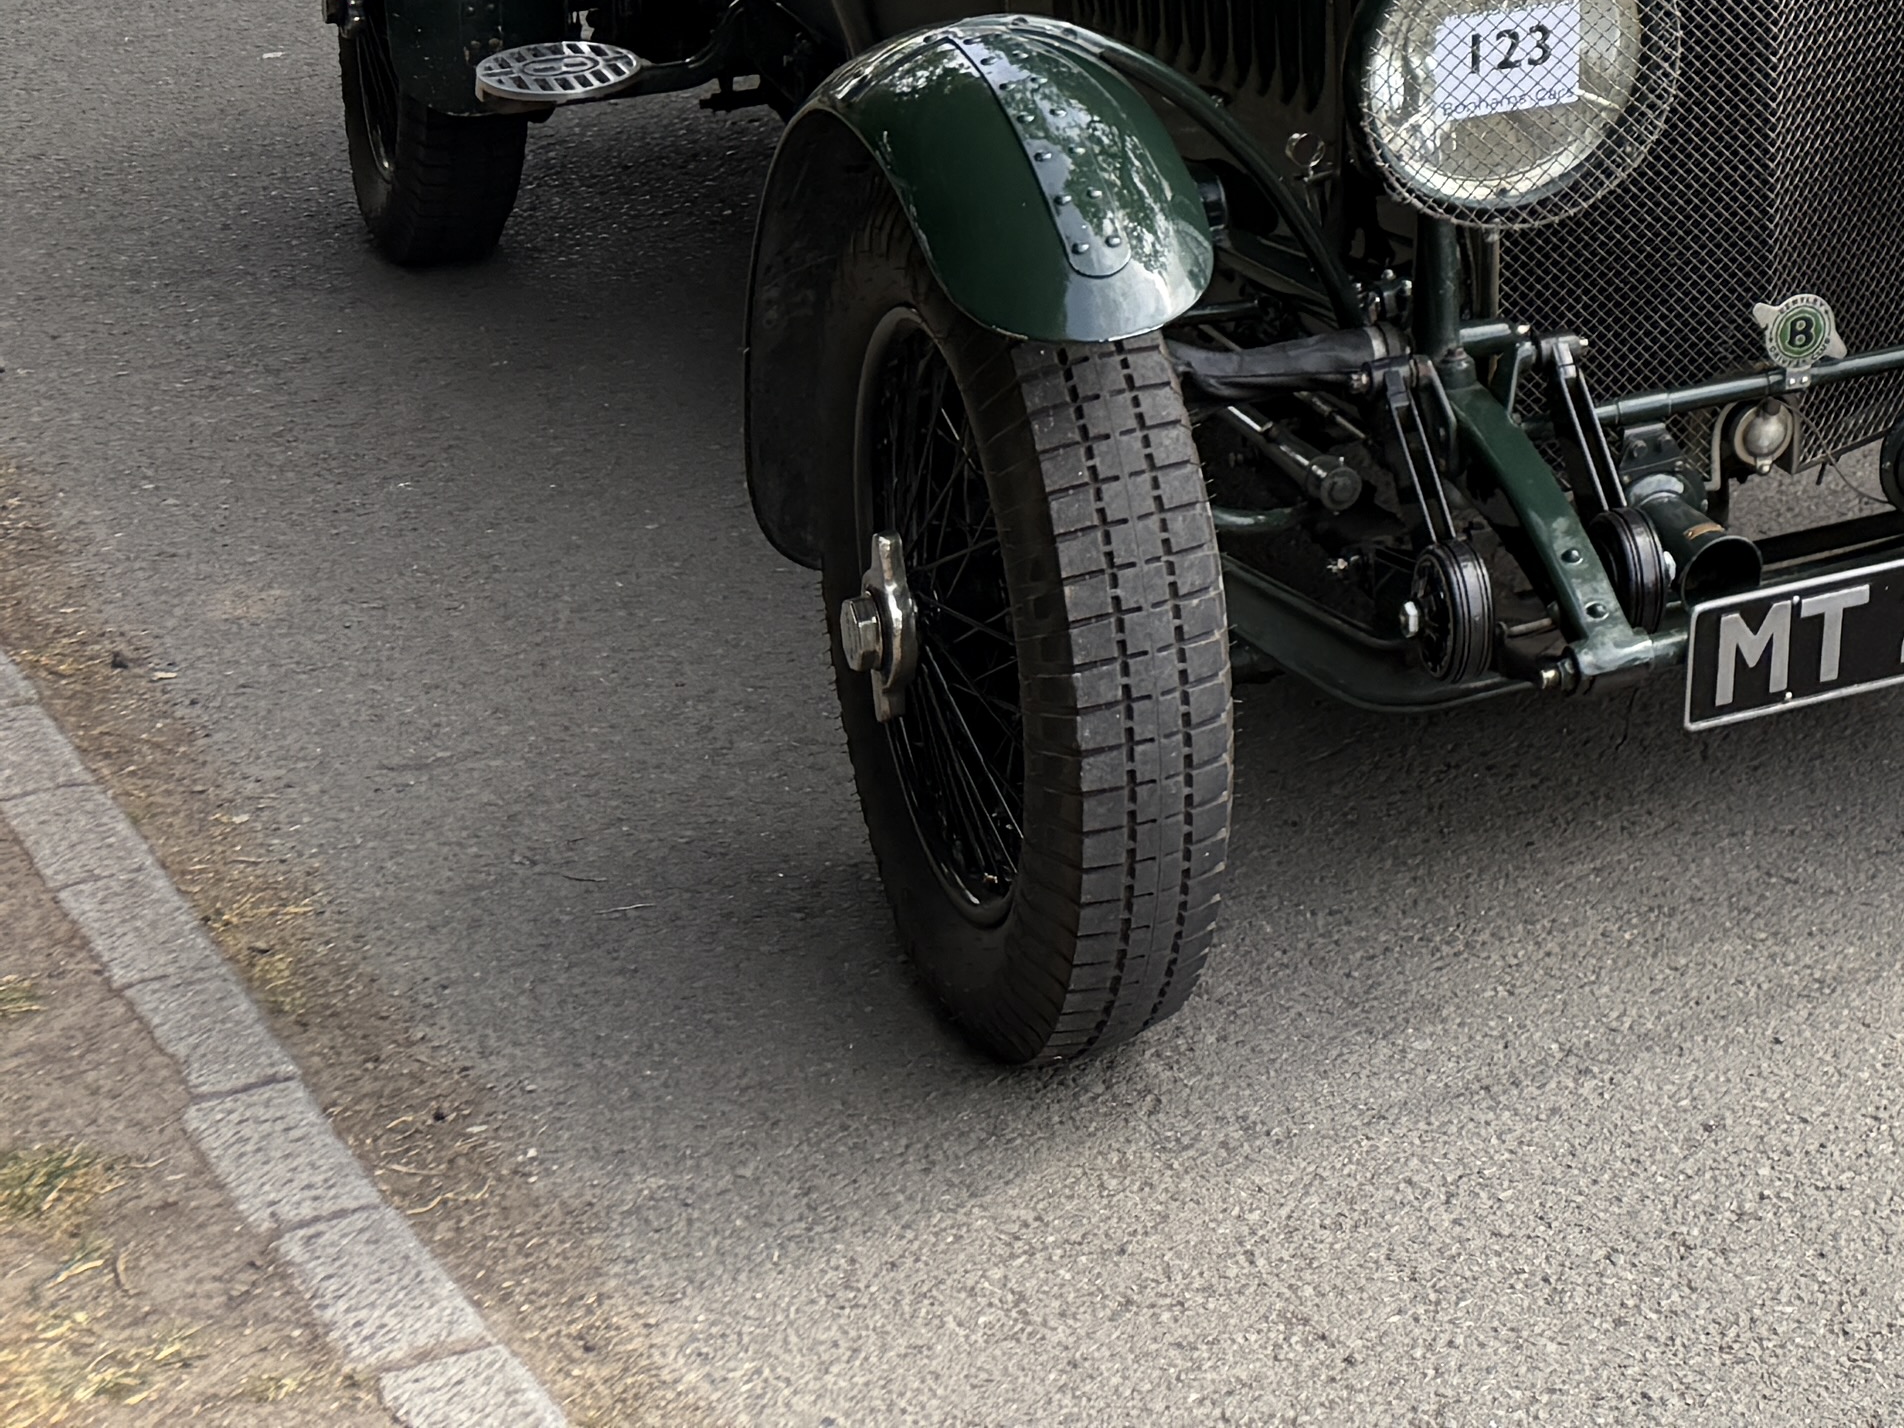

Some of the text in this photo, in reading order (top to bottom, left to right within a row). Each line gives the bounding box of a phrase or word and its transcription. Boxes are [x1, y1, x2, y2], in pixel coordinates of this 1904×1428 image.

[1471, 24, 1552, 74] 123
[1787, 316, 1816, 349] B
[1715, 583, 1871, 707] MT
